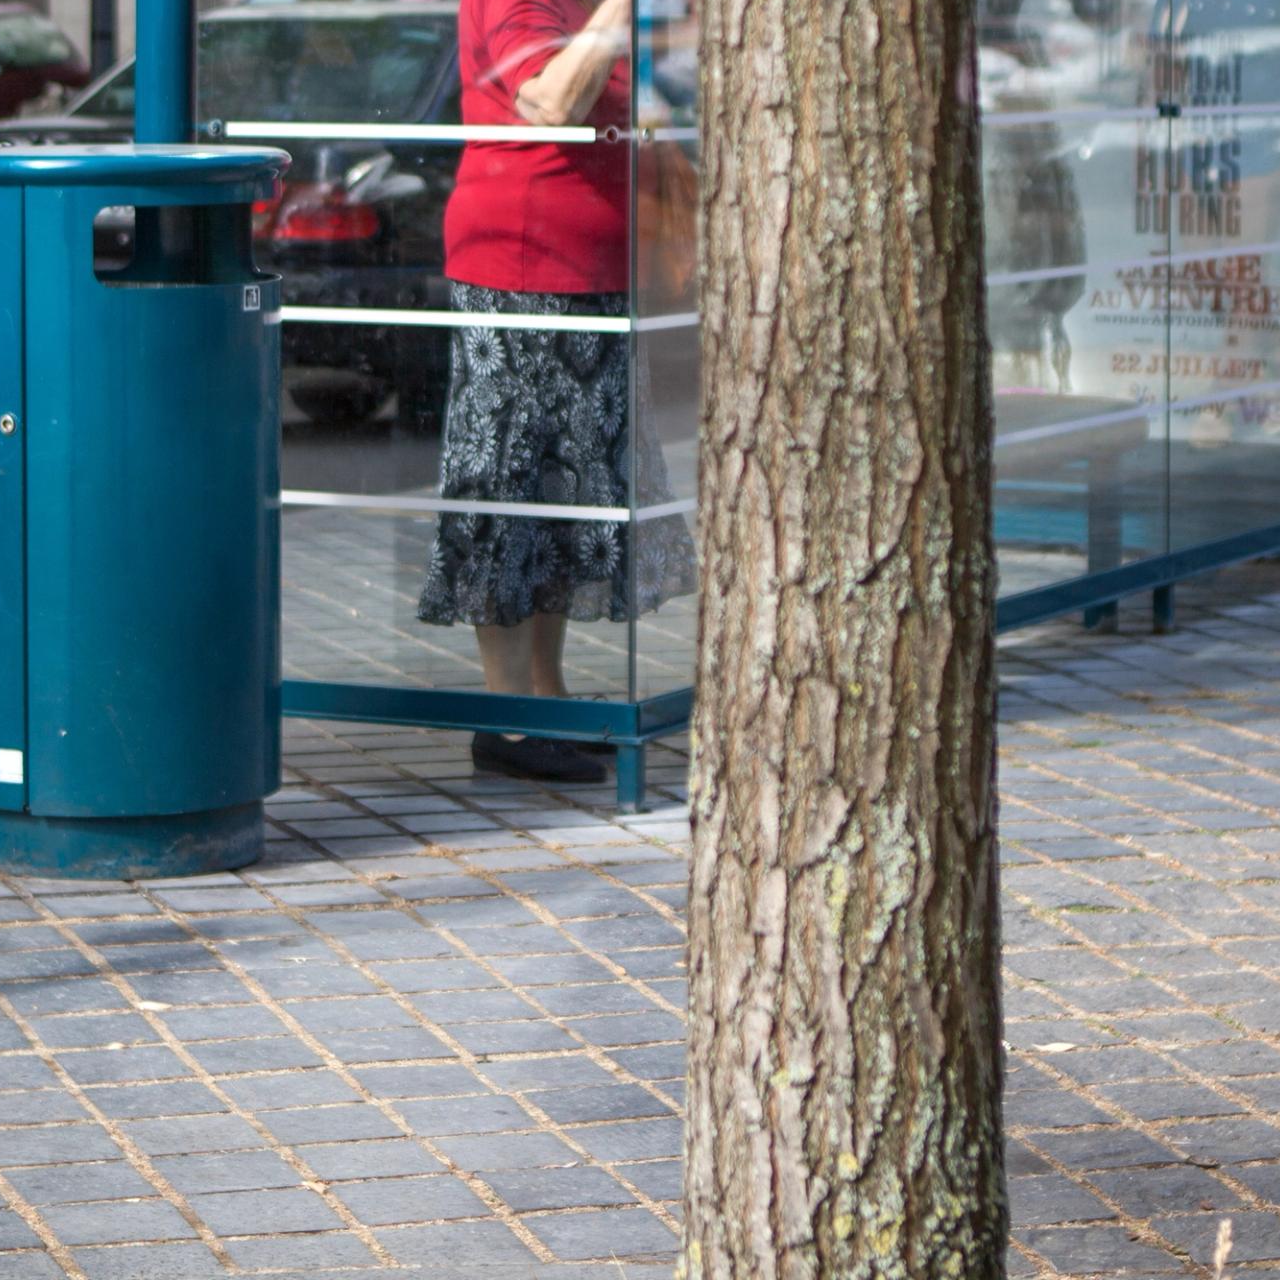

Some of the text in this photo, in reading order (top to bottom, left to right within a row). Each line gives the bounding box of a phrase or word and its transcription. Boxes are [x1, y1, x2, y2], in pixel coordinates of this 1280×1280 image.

[1136, 193, 1241, 236] DU RING
[1150, 254, 1261, 283] RAGE
[1089, 289, 1121, 308] AU
[1112, 352, 1267, 379] 22 JUILLET
